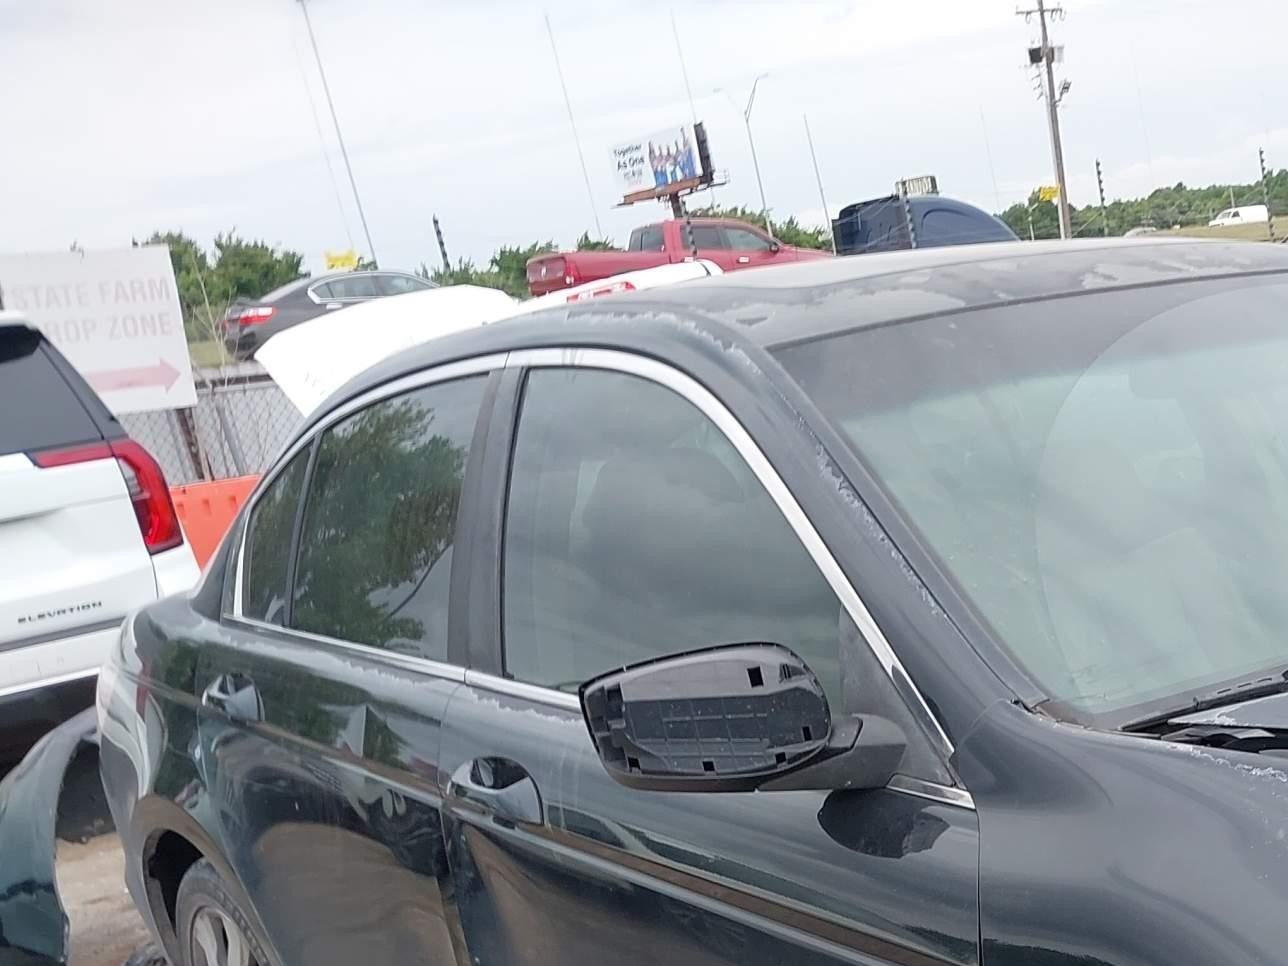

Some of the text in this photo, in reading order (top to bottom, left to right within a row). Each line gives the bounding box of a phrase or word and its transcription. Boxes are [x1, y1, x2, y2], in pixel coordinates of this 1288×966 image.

[11, 277, 171, 312] STATE FARM
[44, 312, 172, 344] ROP ZONE
[18, 600, 102, 623] ELEVATION
